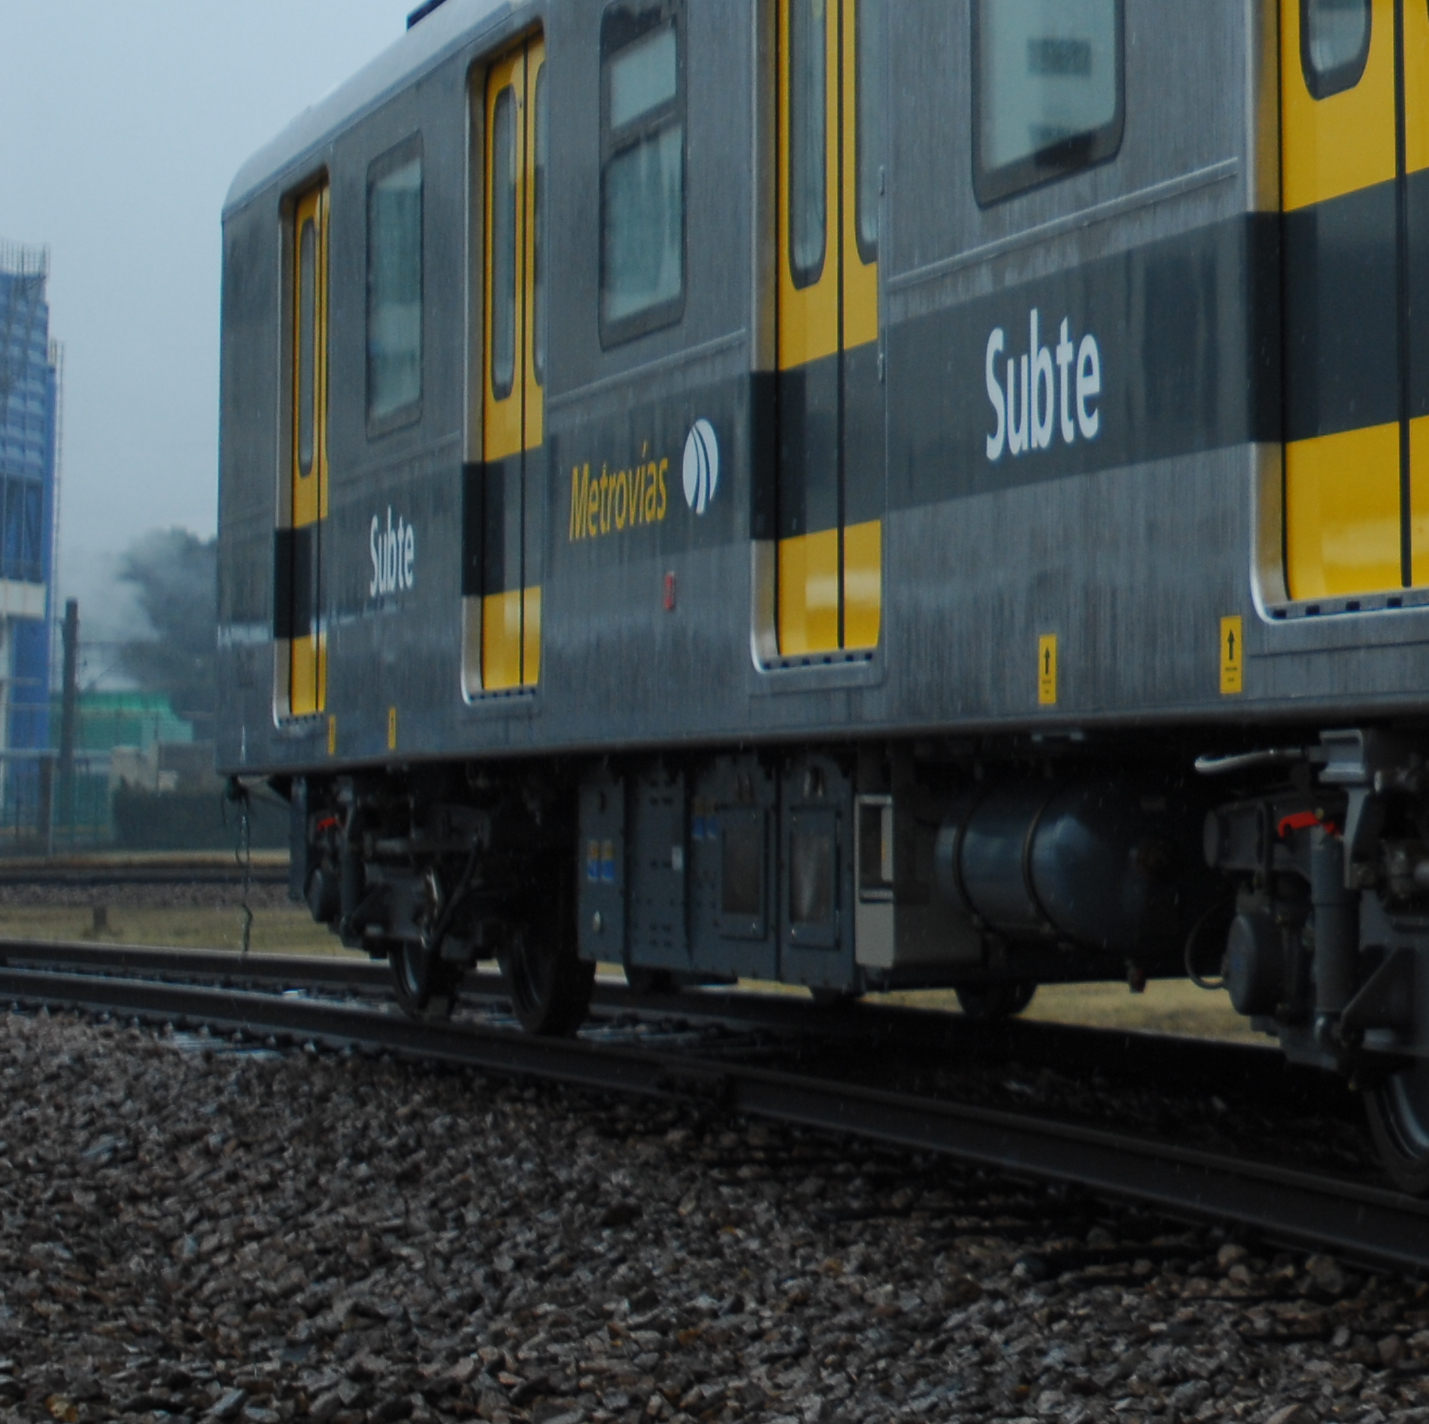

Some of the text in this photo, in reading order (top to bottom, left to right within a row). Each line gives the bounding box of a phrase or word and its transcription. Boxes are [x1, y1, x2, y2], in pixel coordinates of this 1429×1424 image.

[985, 307, 1101, 461] Subte
[569, 439, 669, 542] Metrovías
[369, 504, 415, 598] Subte
